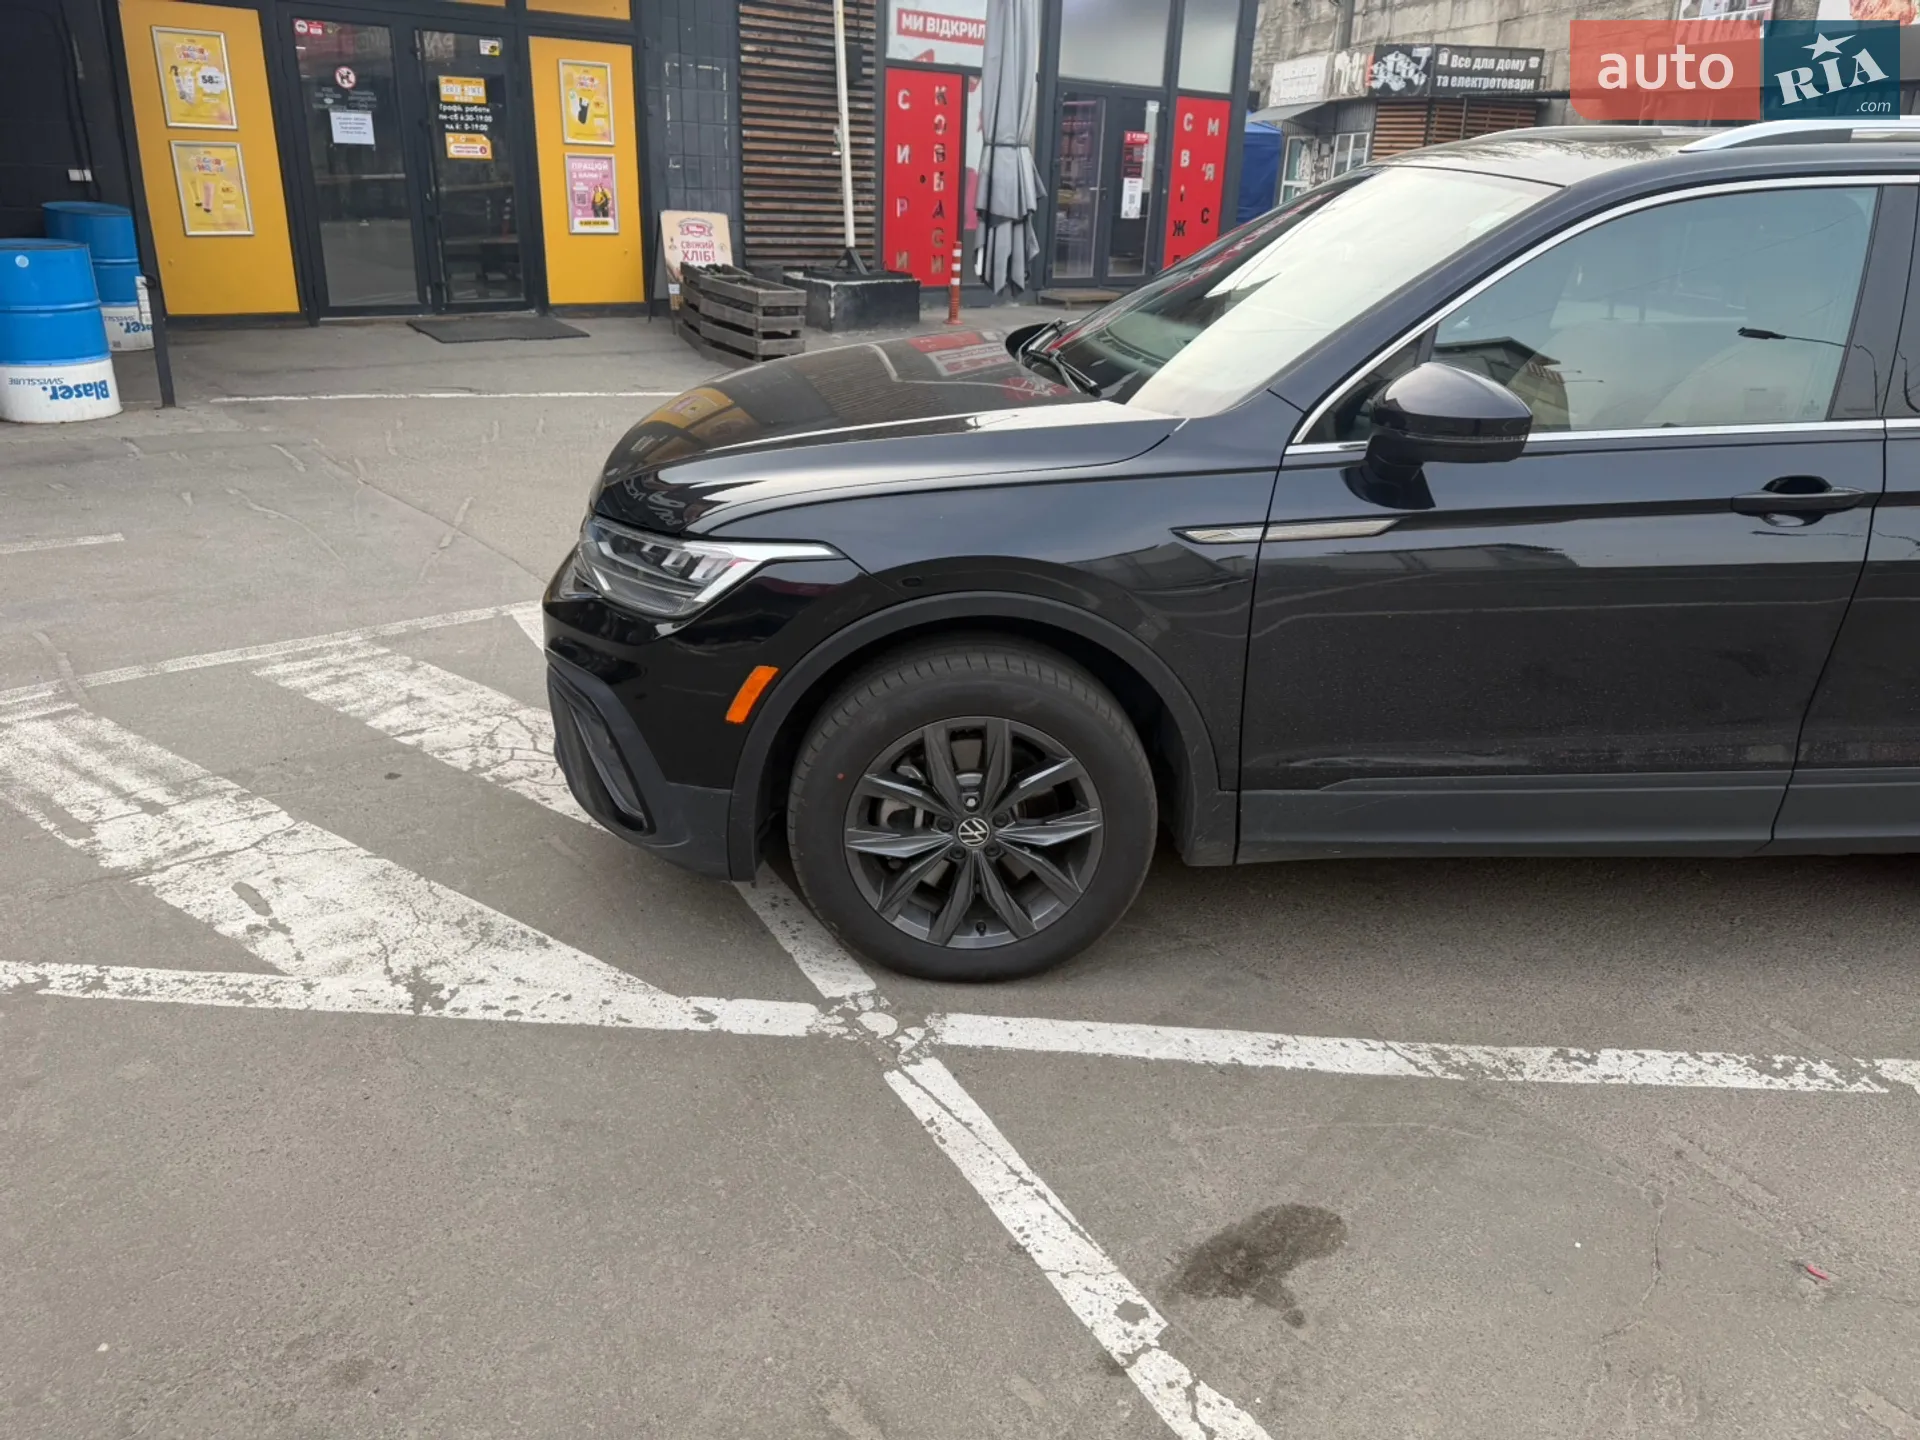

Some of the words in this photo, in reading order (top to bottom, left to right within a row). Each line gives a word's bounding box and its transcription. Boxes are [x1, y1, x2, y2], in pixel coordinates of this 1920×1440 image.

[902, 13, 924, 31] МИ
[1451, 56, 1472, 69] Все
[1473, 57, 1496, 71] для
[1498, 58, 1527, 72] дому
[1436, 76, 1449, 87] та
[1451, 76, 1535, 91] електротовари
[681, 241, 715, 249] СВІЖИЙ
[682, 250, 716, 262] ХЛІБ!
[8, 377, 65, 386] SWISSLUBE
